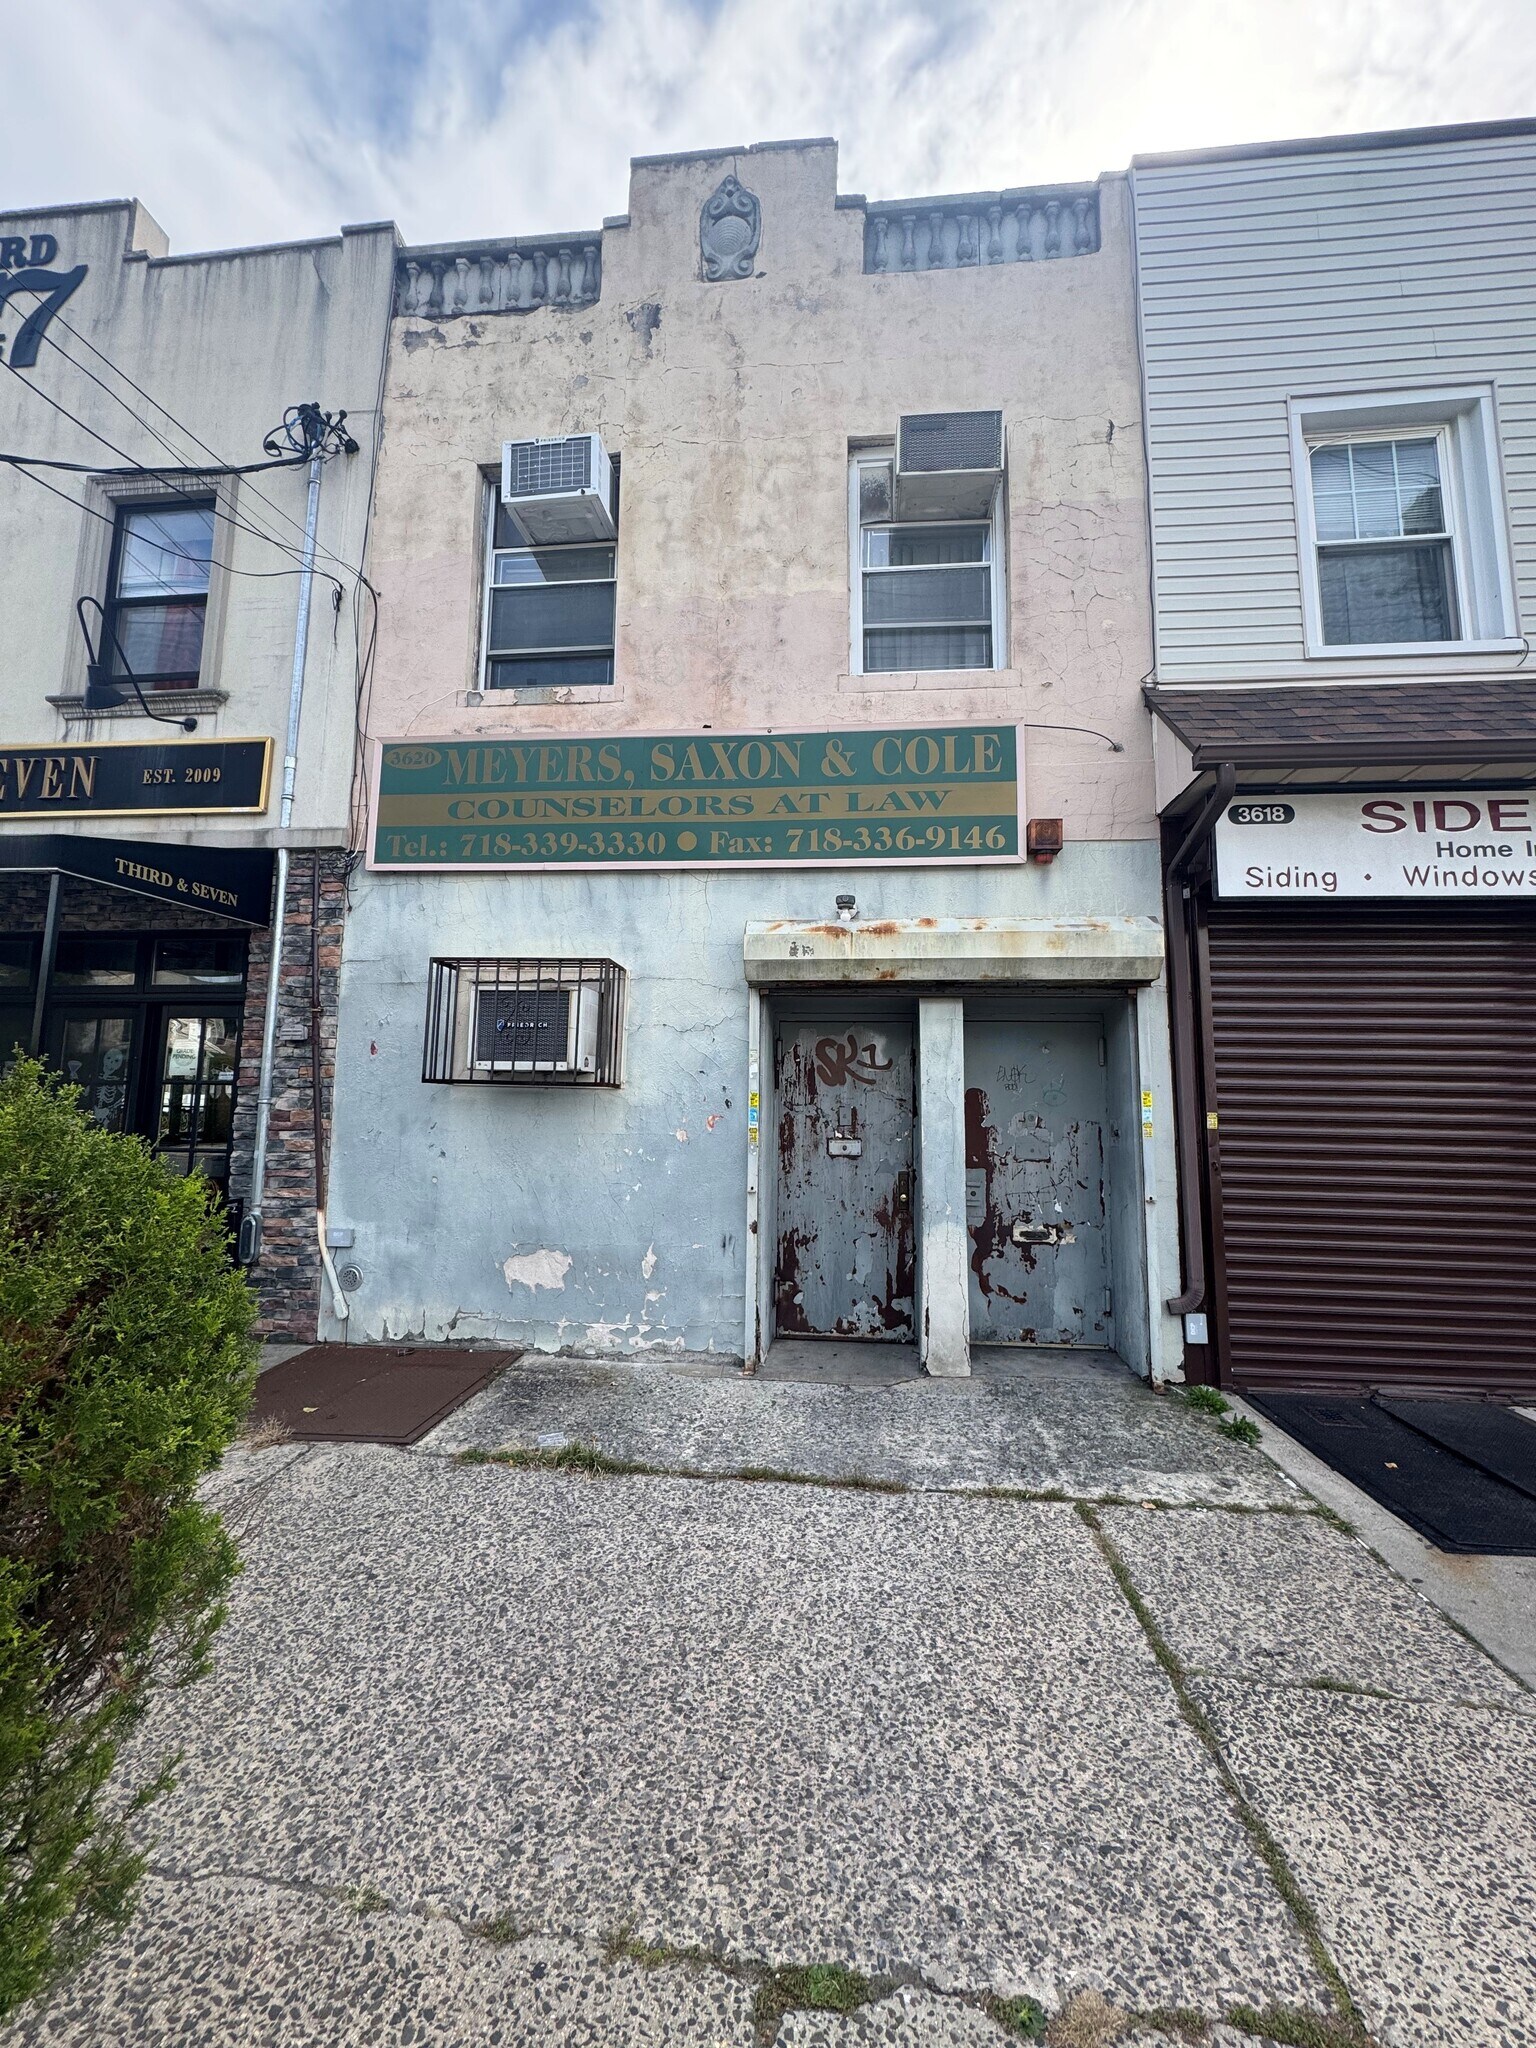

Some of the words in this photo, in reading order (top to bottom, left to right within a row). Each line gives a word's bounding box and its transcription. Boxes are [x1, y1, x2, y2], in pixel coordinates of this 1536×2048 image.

[390, 751, 434, 766] 3620
[442, 744, 634, 790] MEYERS,
[651, 740, 804, 783] SAXON
[821, 738, 857, 777] &
[872, 734, 1003, 776] COLE
[142, 768, 176, 784] EST.
[185, 767, 221, 783] 2009
[447, 795, 755, 820] COUNSELORS
[767, 792, 831, 815] AT
[845, 790, 953, 812] LAW
[1237, 807, 1286, 823] 3618
[1361, 799, 1533, 834] SIDE
[386, 834, 447, 857] Tel.:
[460, 831, 666, 857] 718-339-3330
[708, 829, 772, 855] Fax:
[786, 824, 1006, 852] 718-336-9146
[1436, 841, 1513, 858] Home
[115, 857, 173, 888] THIRD
[177, 878, 189, 892] &
[191, 881, 238, 907] SEVEN
[1245, 866, 1338, 892] Siding
